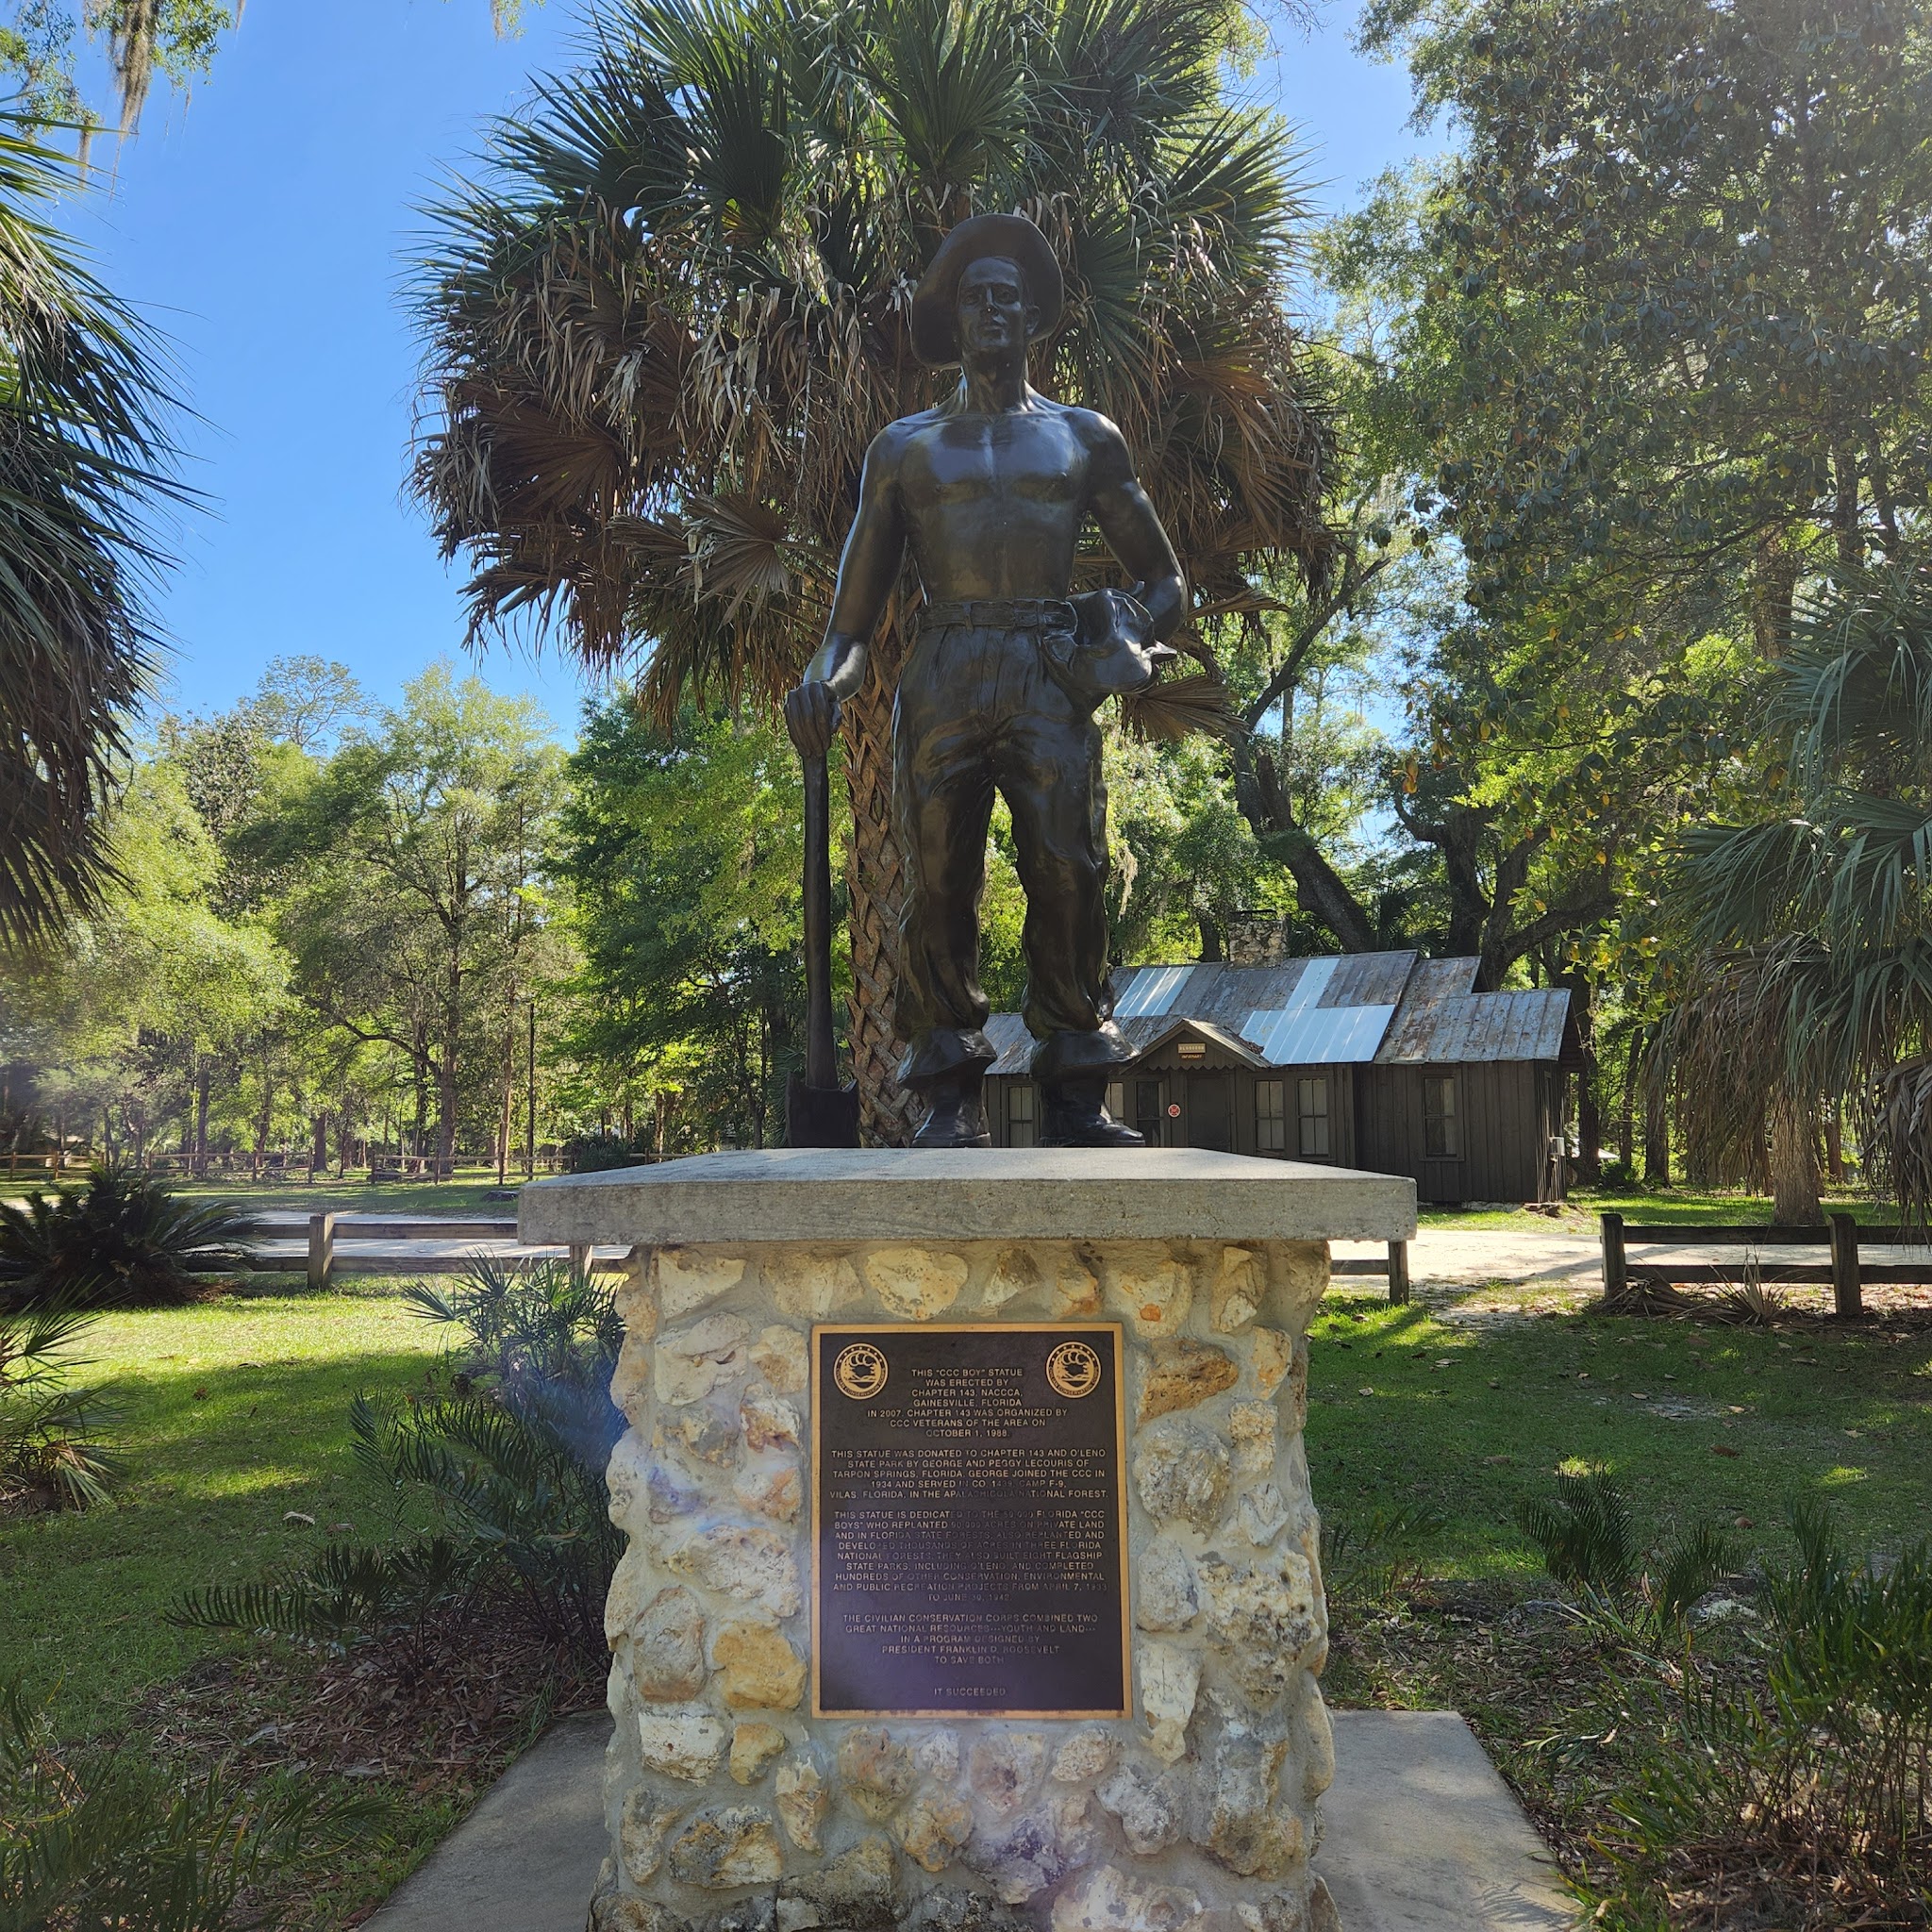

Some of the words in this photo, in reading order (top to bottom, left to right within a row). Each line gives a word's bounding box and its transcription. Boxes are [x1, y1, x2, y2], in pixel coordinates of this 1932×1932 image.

[849, 1352, 874, 1367] CCC
[1062, 1351, 1086, 1365] CCC
[911, 1369, 933, 1377] THIS
[988, 1369, 1023, 1377] STATUE
[925, 1378, 946, 1387] WAS
[949, 1378, 993, 1387] ERECTED
[996, 1378, 1008, 1387] BY
[911, 1389, 957, 1397] CHAPTER
[981, 1398, 1022, 1407] FLORIDA
[867, 1408, 877, 1418] IN
[907, 1408, 952, 1418] CHAPTER
[956, 1408, 971, 1418] 143
[974, 1408, 994, 1418] WAS
[997, 1408, 1053, 1418] ORGANIZED
[1055, 1408, 1067, 1418] BY
[890, 1419, 910, 1427] CCC
[912, 1419, 963, 1427] VETERANS
[966, 1419, 978, 1427] OF
[982, 1419, 1000, 1427] THE
[1004, 1419, 1028, 1427] AREA
[1031, 1419, 1046, 1427] ON
[925, 1429, 972, 1438] OCTOBER
[831, 1449, 853, 1457] THIS
[857, 1449, 891, 1457] STATUE
[894, 1449, 915, 1457] WAS
[917, 1449, 962, 1457] DONATED
[966, 1449, 977, 1457] TO
[980, 1449, 1025, 1457] CHAPTER
[1029, 1449, 1044, 1457] 143
[1047, 1449, 1067, 1457] AND
[1070, 1449, 1106, 1457] O'LENO
[847, 1459, 875, 1468] STATE
[879, 1459, 904, 1468] PARK
[907, 1459, 919, 1468] BY
[922, 1459, 962, 1468] GEORGE
[966, 1459, 986, 1468] AND
[989, 1459, 1022, 1468] PEGGY
[1024, 1459, 1074, 1468] LECOURIS
[1075, 1459, 1089, 1468] OF
[833, 1470, 871, 1478] TARPON
[968, 1470, 1008, 1478] GEORGE
[1012, 1470, 1047, 1478] JOINED
[1050, 1470, 1068, 1478] THE
[1072, 1470, 1091, 1478] CCC
[1094, 1470, 1106, 1478] IN
[872, 1480, 892, 1489] 1934
[895, 1480, 915, 1489] AND
[918, 1480, 957, 1489] SERVED
[958, 1480, 969, 1489] IN
[1019, 1480, 1046, 1489] CAMP
[909, 1491, 920, 1499] IN
[923, 1491, 941, 1499] THE
[1019, 1491, 1065, 1499] NATIONAL
[834, 1510, 856, 1519] THIS
[859, 1510, 893, 1519] STATUE
[897, 1510, 907, 1519] IS
[909, 1510, 963, 1519] DEDICATED
[967, 1510, 978, 1519] TO
[982, 1510, 999, 1519] THE
[1036, 1510, 1077, 1519] FLORIDA
[866, 1521, 889, 1529] WHO
[891, 1521, 948, 1529] REPLANTED
[984, 1521, 1016, 1529] ACRES
[1020, 1521, 1034, 1529] ON
[1037, 1521, 1075, 1529] PRIVATE
[1078, 1521, 1105, 1529] LAND
[835, 1531, 855, 1540] AND
[858, 1531, 867, 1540] IN
[870, 1531, 911, 1540] FLORIDA
[916, 1531, 941, 1540] STATE
[996, 1531, 1022, 1540] ALSO
[1085, 1531, 1105, 1540] AND
[838, 1541, 895, 1550] DEVELOPED
[899, 1541, 958, 1550] THOUSANDS
[961, 1541, 973, 1550] OF
[1059, 1541, 1101, 1550] FLORIDA
[837, 1552, 882, 1560] NATIONAL
[937, 1552, 961, 1560] THEY
[1023, 1552, 1052, 1560] EIGHT
[1055, 1552, 1103, 1560] FLAGSHIP
[846, 1562, 874, 1571] STATE
[914, 1562, 967, 1571] INCLUDING
[1012, 1562, 1031, 1571] AND
[1035, 1562, 1094, 1571] COMPLETED
[835, 1573, 889, 1581] HUNDREDS
[891, 1573, 904, 1581] OF
[1024, 1573, 1105, 1581] ENVIRONMENTAL
[833, 1582, 853, 1591] AND
[856, 1582, 891, 1591] PUBLIC
[1011, 1582, 1040, 1591] FROM
[928, 1592, 941, 1602] TO
[943, 1592, 967, 1602] JUNE
[843, 1613, 860, 1623] THE
[864, 1613, 906, 1623] CIVILIAN
[908, 1613, 983, 1623] CONSERVATION
[985, 1613, 1020, 1623] CORPS
[1022, 1613, 1074, 1623] COMBINED
[1076, 1613, 1099, 1623] TWO
[845, 1624, 876, 1633] GREAT
[880, 1624, 925, 1633] NATIONAL
[1037, 1624, 1056, 1633] AND
[900, 1635, 910, 1643] IN
[913, 1635, 921, 1643] A
[924, 1635, 971, 1643] PROGRAM
[881, 1645, 936, 1654] PRESIDENT
[940, 1645, 988, 1654] FRANKLIN
[935, 1656, 947, 1664] TO
[934, 1688, 942, 1696] IT
